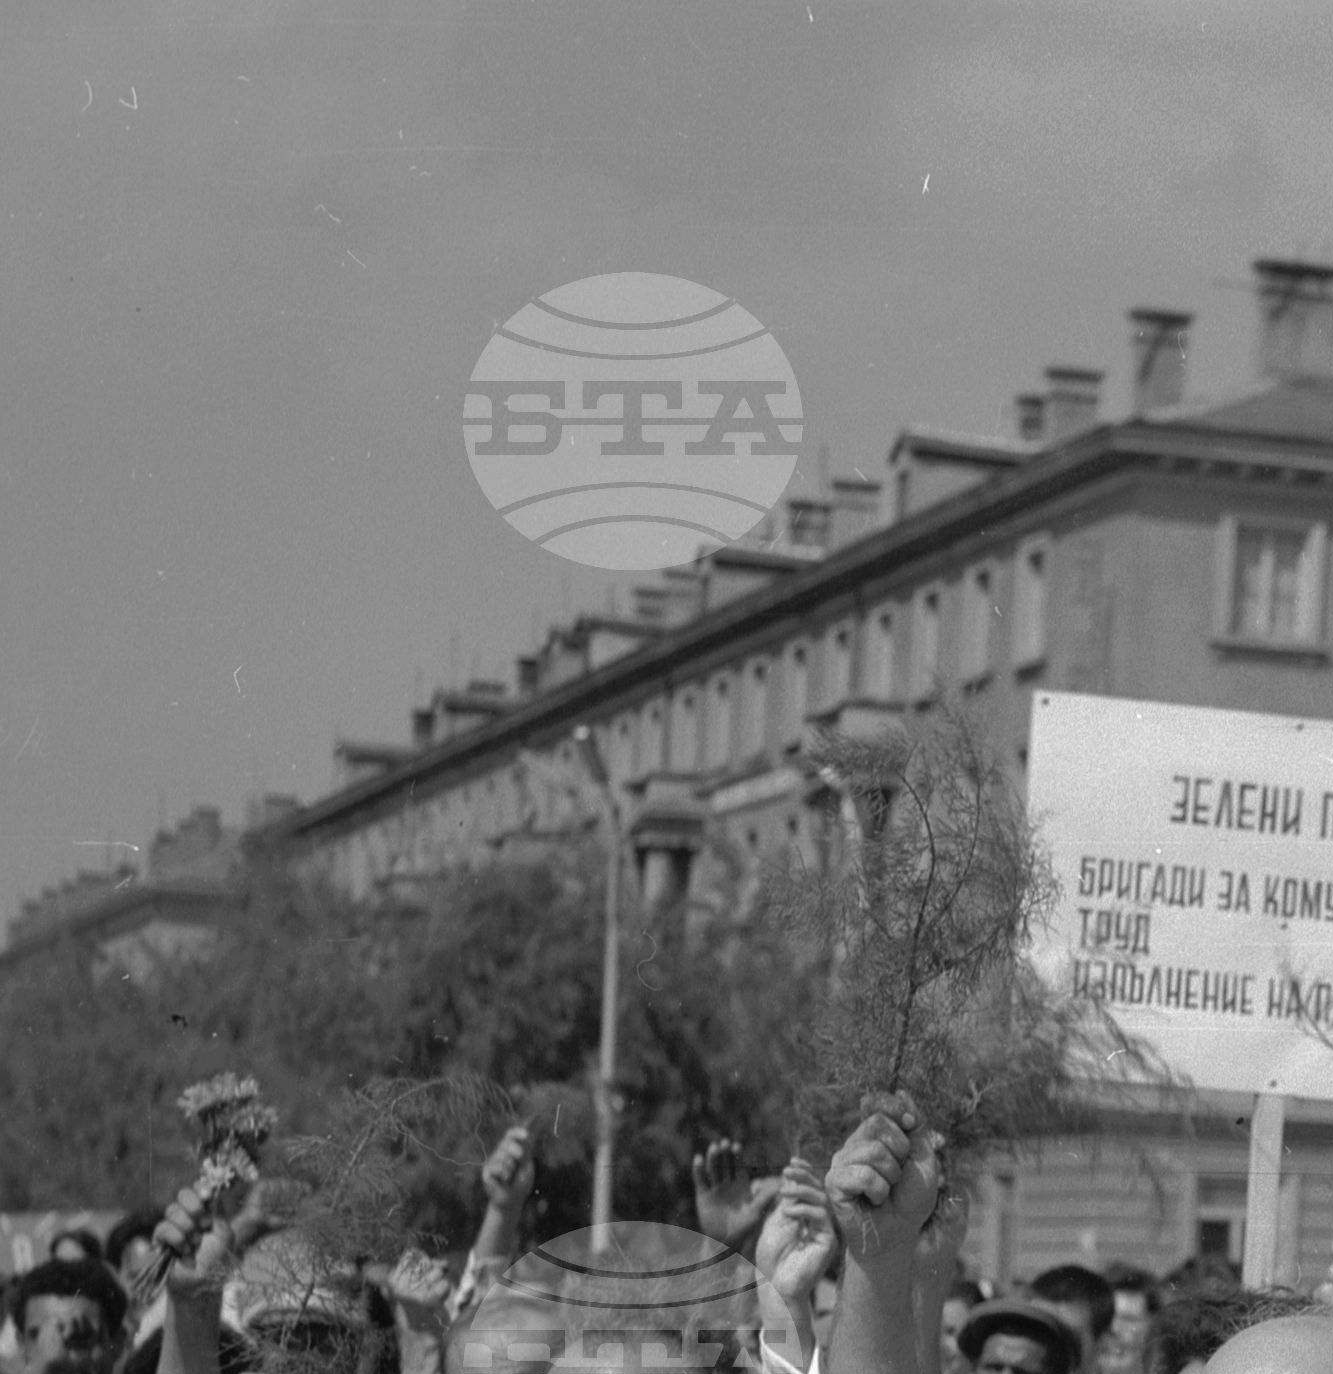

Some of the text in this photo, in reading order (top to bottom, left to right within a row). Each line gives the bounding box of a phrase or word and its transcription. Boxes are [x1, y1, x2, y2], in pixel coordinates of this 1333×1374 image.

[1169, 774, 1304, 836] ЗЕЛЕНИ
[1077, 855, 1206, 909] БРИГАДИ
[1216, 869, 1251, 914] ЗА
[1077, 907, 1151, 956] ТРУД
[1072, 958, 1255, 1015] ИЗПЪЛНЕНИЕ
[1267, 975, 1301, 1019] НА
